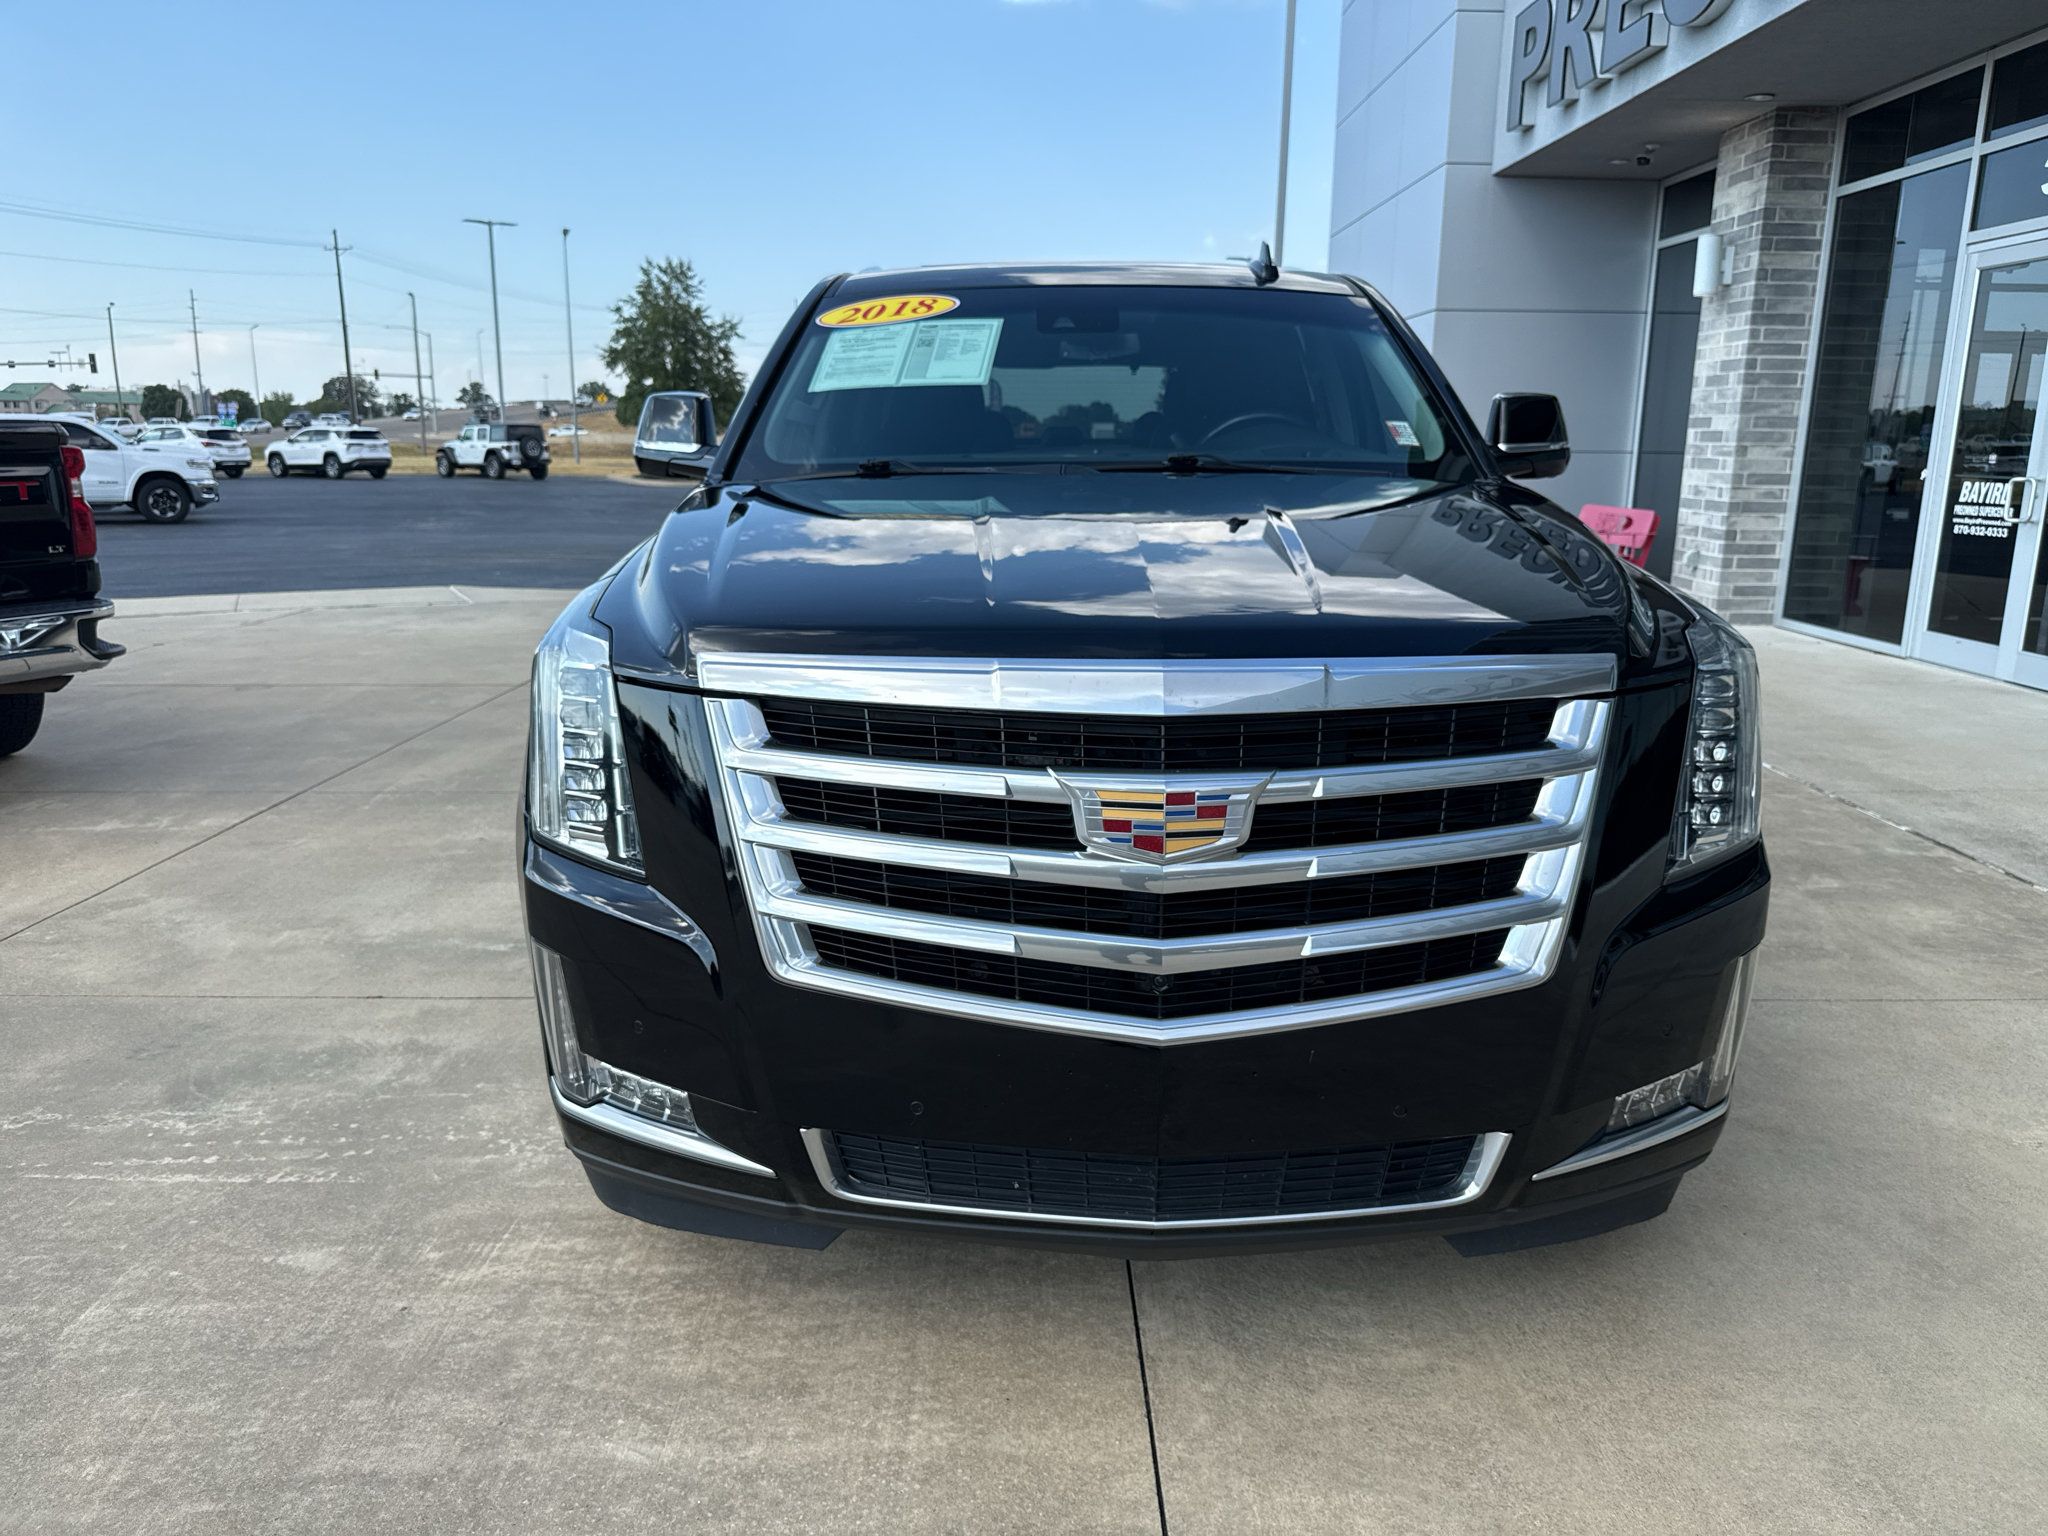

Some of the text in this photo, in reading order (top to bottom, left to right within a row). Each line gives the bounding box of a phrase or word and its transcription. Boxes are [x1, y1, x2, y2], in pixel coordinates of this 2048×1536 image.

[1507, 0, 1714, 132] PRE
[837, 299, 938, 325] 2018
[1979, 506, 2014, 518] SUPERCENR
[1953, 525, 2009, 538] 870-932-0333
